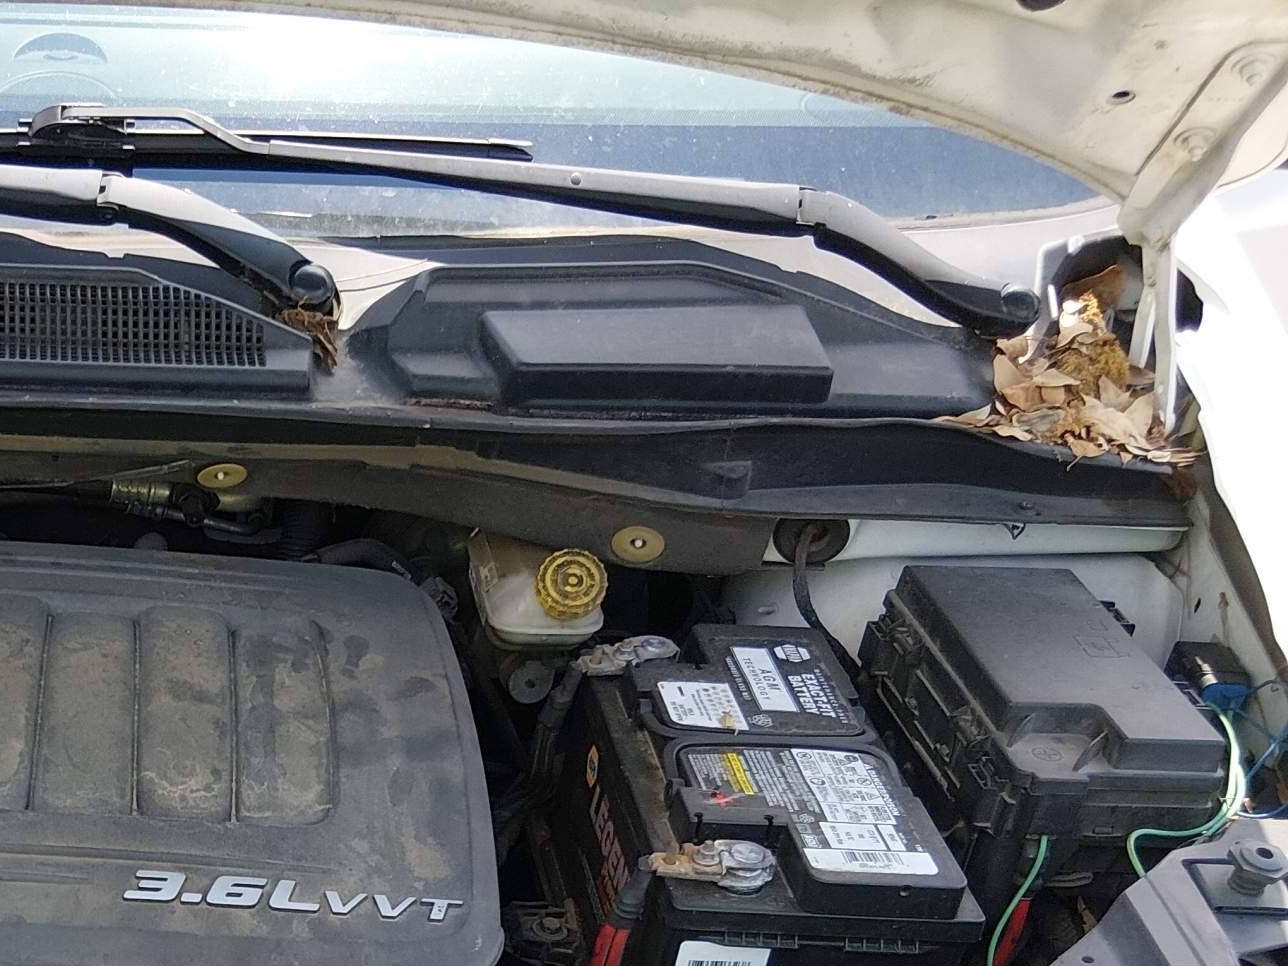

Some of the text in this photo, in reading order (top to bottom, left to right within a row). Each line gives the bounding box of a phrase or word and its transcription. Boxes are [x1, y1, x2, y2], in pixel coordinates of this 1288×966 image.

[743, 658, 770, 700] TECHNOLOGY
[759, 668, 783, 692] AGM
[788, 675, 820, 715] BATTERY
